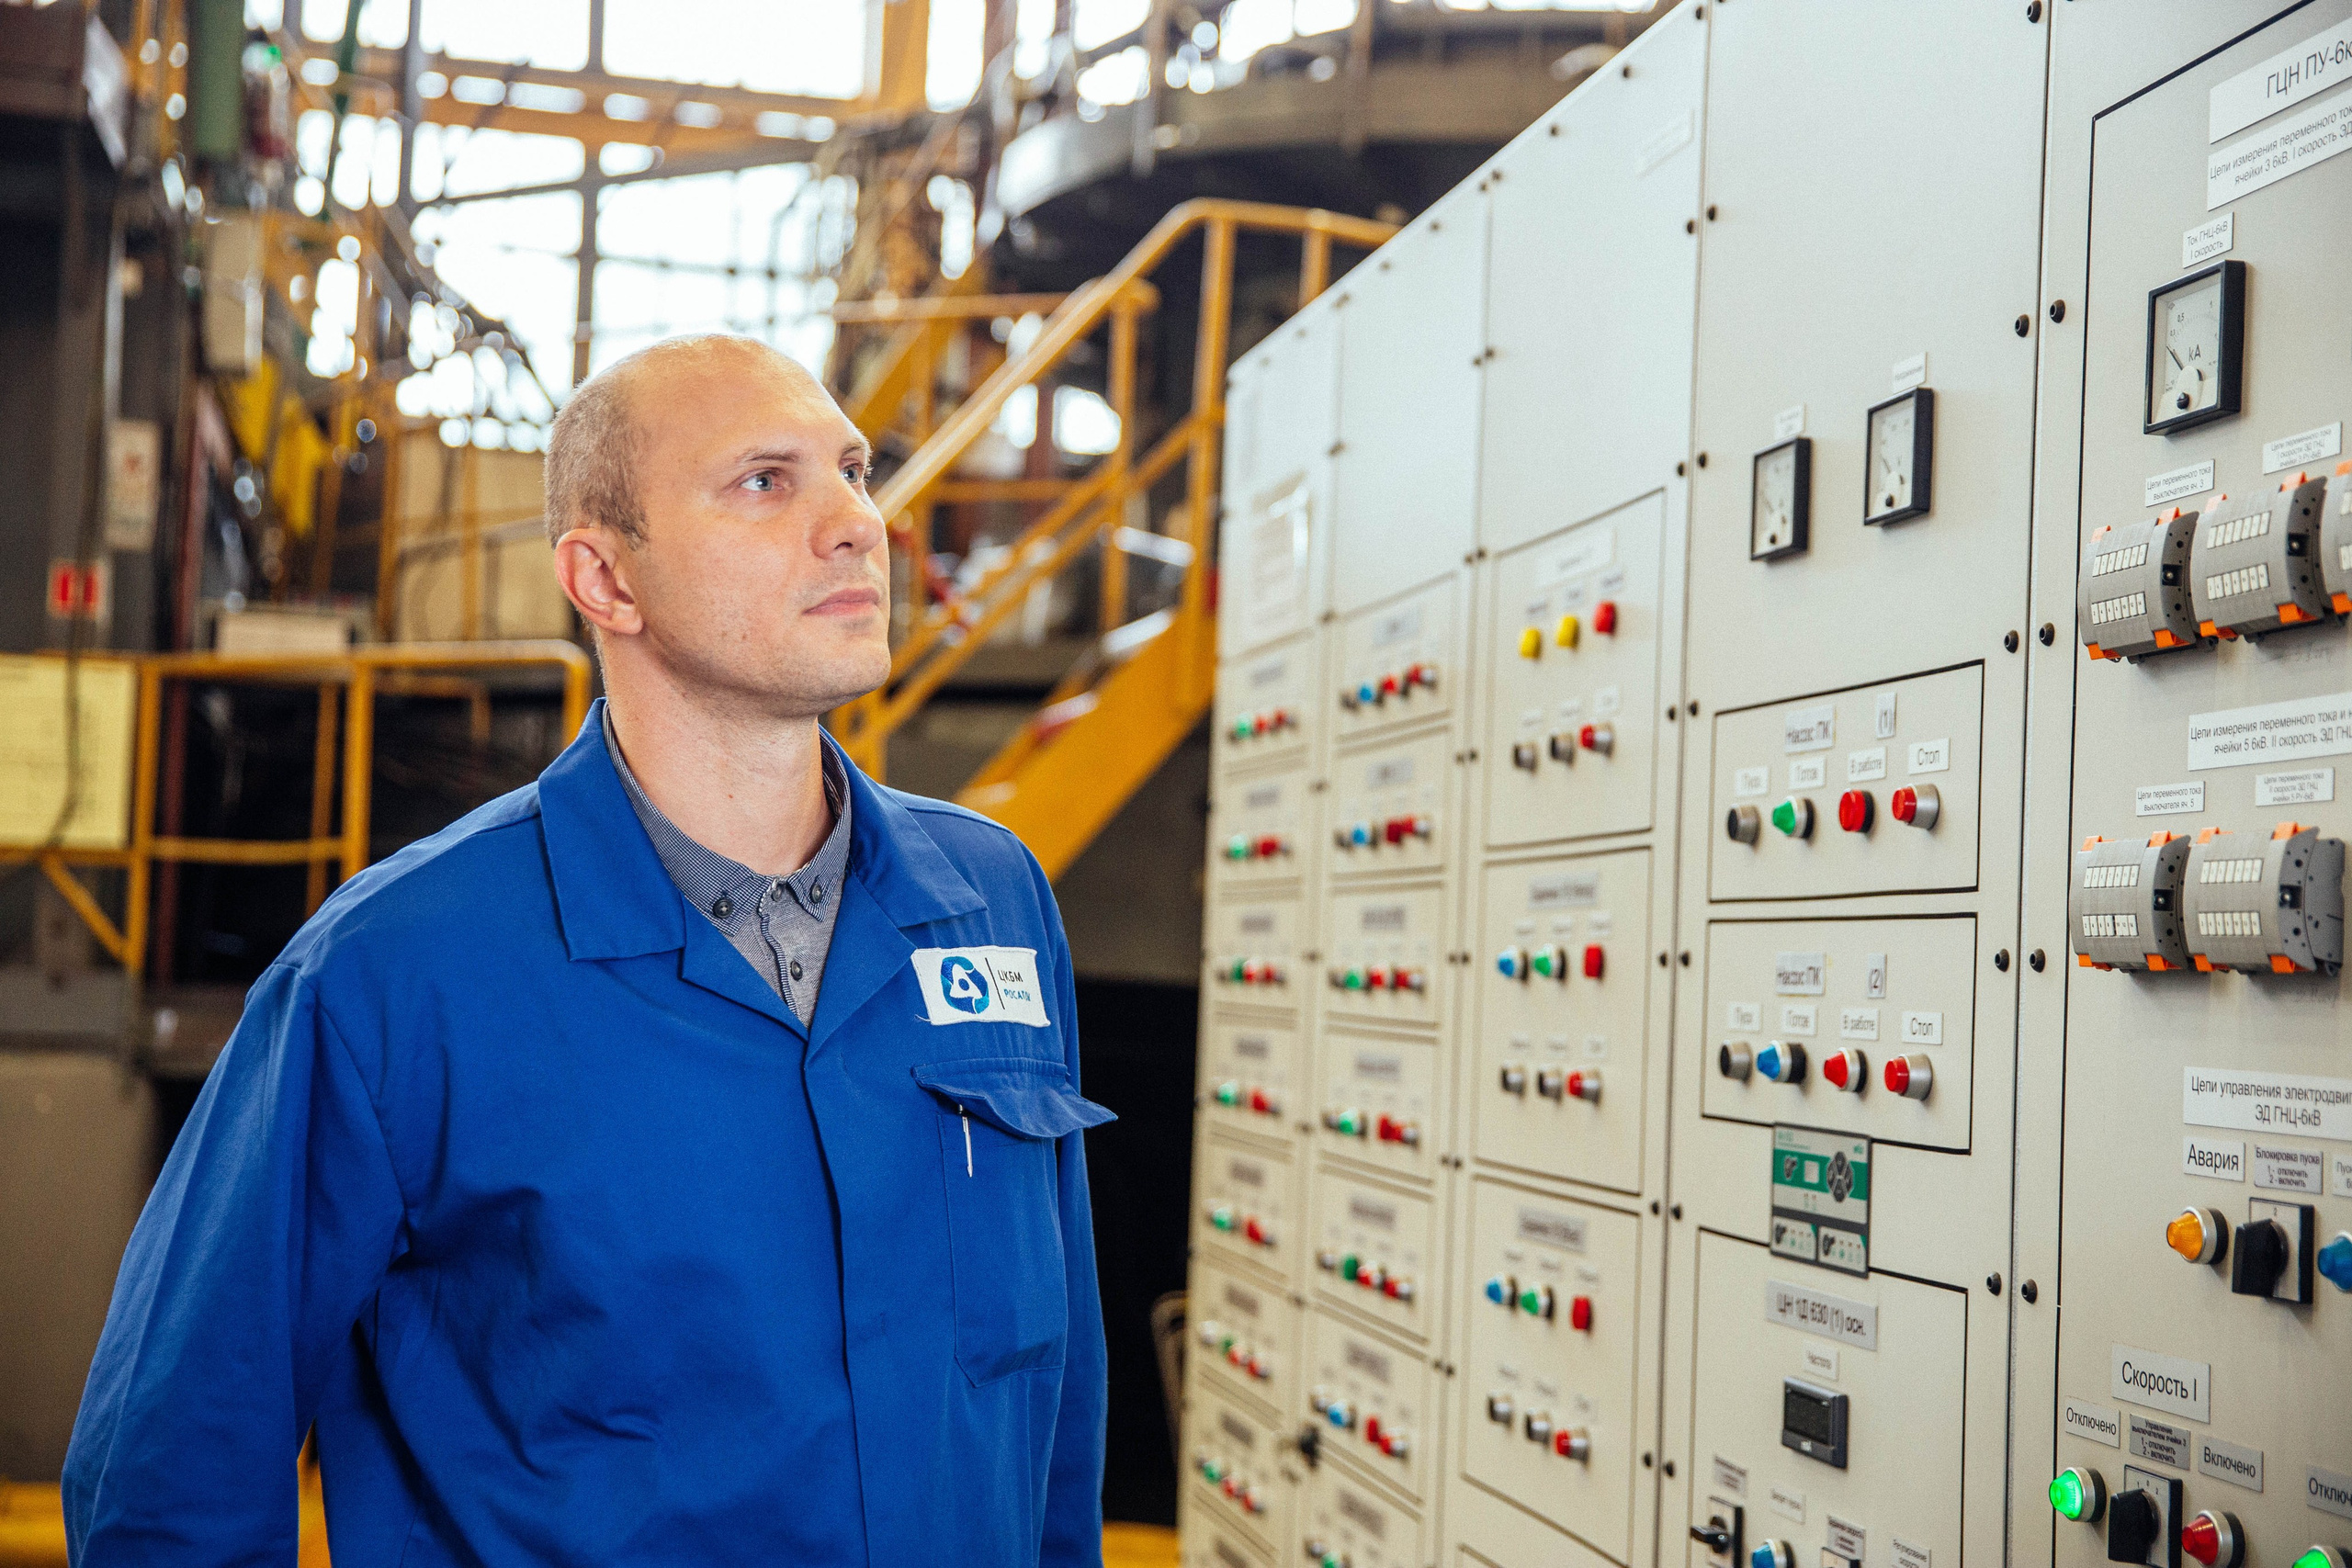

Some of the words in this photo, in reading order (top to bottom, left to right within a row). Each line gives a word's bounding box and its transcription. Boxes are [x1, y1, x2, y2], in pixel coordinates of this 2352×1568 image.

[2267, 62, 2300, 98] ГЦН
[2210, 163, 2231, 180] Цепи
[2233, 140, 2278, 169] измерения
[2279, 112, 2337, 147] переменного
[2234, 164, 2263, 186] ячейки
[2265, 160, 2271, 172] 3
[2298, 135, 2337, 158] скорость
[2187, 235, 2199, 247] Ток
[2199, 220, 2228, 243] ГНЦ-6кВ
[2194, 241, 2223, 260] скорость
[2147, 478, 2160, 491] Цепи
[2161, 472, 2198, 490] переменного
[2199, 466, 2211, 476] тока
[2154, 486, 2189, 501] выключателя
[2199, 479, 2204, 488] 3
[2190, 727, 2211, 742] Цепи
[2213, 721, 2257, 739] измерения
[2259, 713, 2316, 733] переменного
[2318, 710, 2338, 723] тока
[2340, 710, 2346, 719] и
[2214, 738, 2243, 754] ячейки
[2244, 739, 2250, 751] 5
[2252, 736, 2269, 750] 6кВ.
[2278, 732, 2317, 750] скорость
[2320, 728, 2334, 743] ЭД
[1917, 748, 1939, 766] Стоп
[2137, 789, 2152, 800] Цепи
[2152, 787, 2188, 801] переменного
[2188, 786, 2201, 795] тока
[2143, 800, 2180, 812] выключателя
[2190, 798, 2195, 807] 5
[997, 969, 1023, 983] ЦКБМ
[1869, 968, 1883, 995] (2)
[1911, 1017, 1934, 1036] Стоп
[2191, 1076, 2217, 1096] Цепи
[2220, 1081, 2282, 1099] управления
[2255, 1104, 2271, 1124] ЭД
[2274, 1106, 2322, 1128] ГНЦ-6кВ
[2187, 1144, 2239, 1173] Авария
[2256, 1147, 2298, 1162] Блокировка
[2300, 1152, 2321, 1166] пуска
[2268, 1175, 2274, 1184] 2
[2278, 1178, 2307, 1188] включить
[2278, 1167, 2309, 1179] отключить
[2121, 1360, 2188, 1399] Скорость
[2066, 1406, 2117, 1436] Отключено
[2141, 1437, 2144, 1446] 1
[2148, 1440, 2176, 1456] отключить
[2182, 1438, 2187, 1448] 3
[2143, 1446, 2147, 1456] 2
[2150, 1450, 2176, 1464] включить
[2204, 1446, 2256, 1478] Включено
